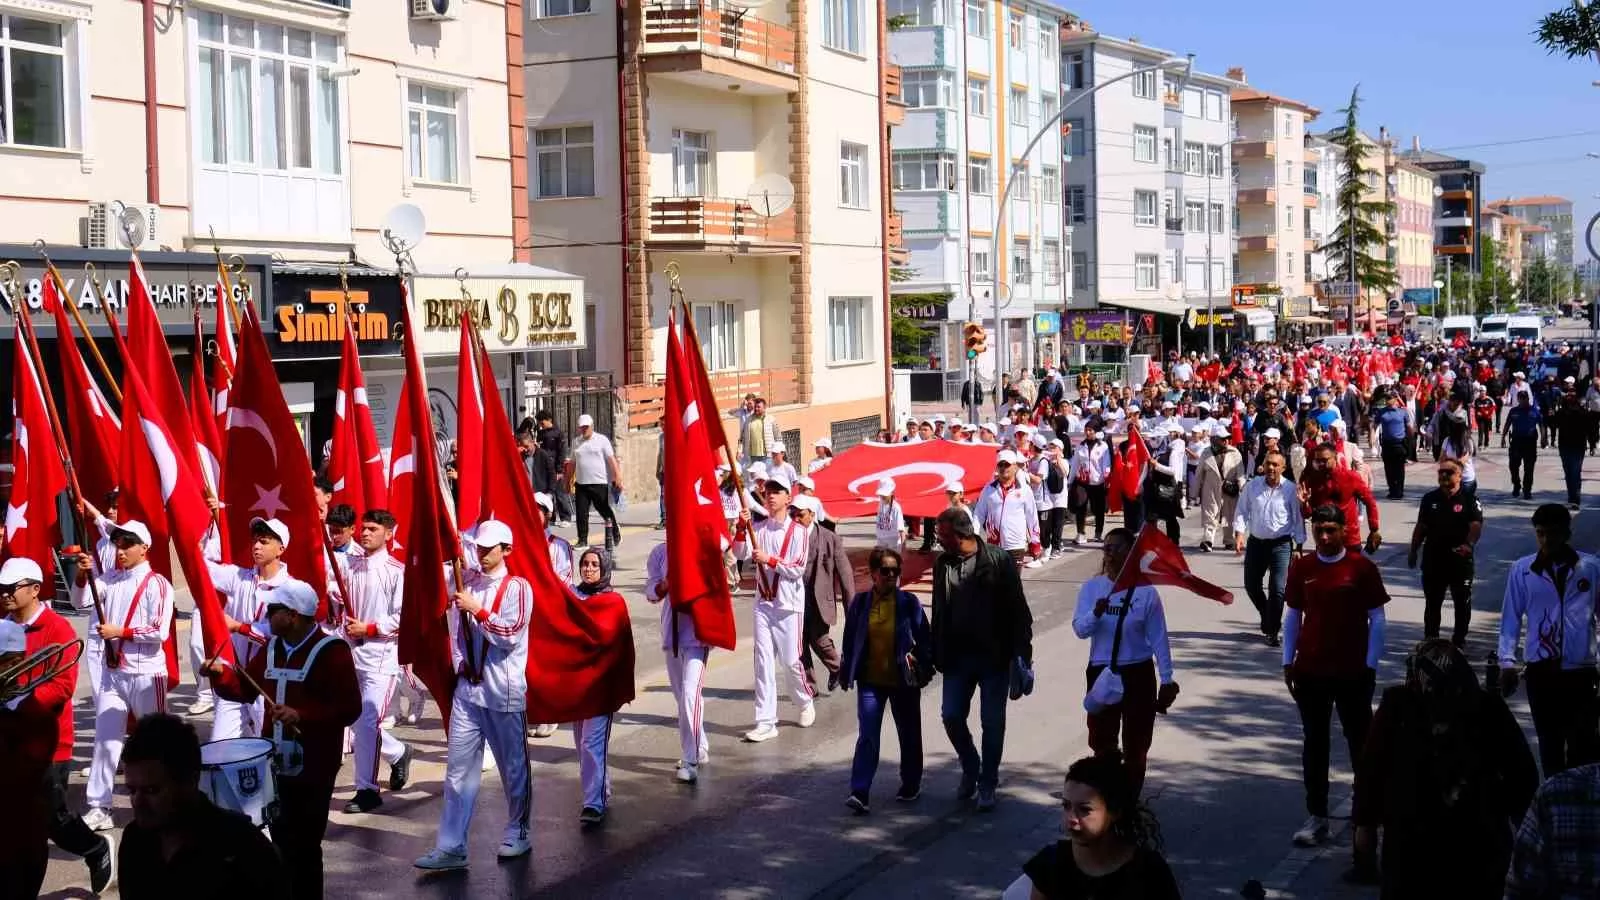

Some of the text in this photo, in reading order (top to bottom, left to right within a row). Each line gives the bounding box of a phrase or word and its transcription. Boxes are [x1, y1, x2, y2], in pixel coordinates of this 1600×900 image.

[25, 278, 43, 309] &
[149, 284, 188, 303] HAIR
[195, 284, 252, 304] DEGN
[528, 293, 572, 328] ECE
